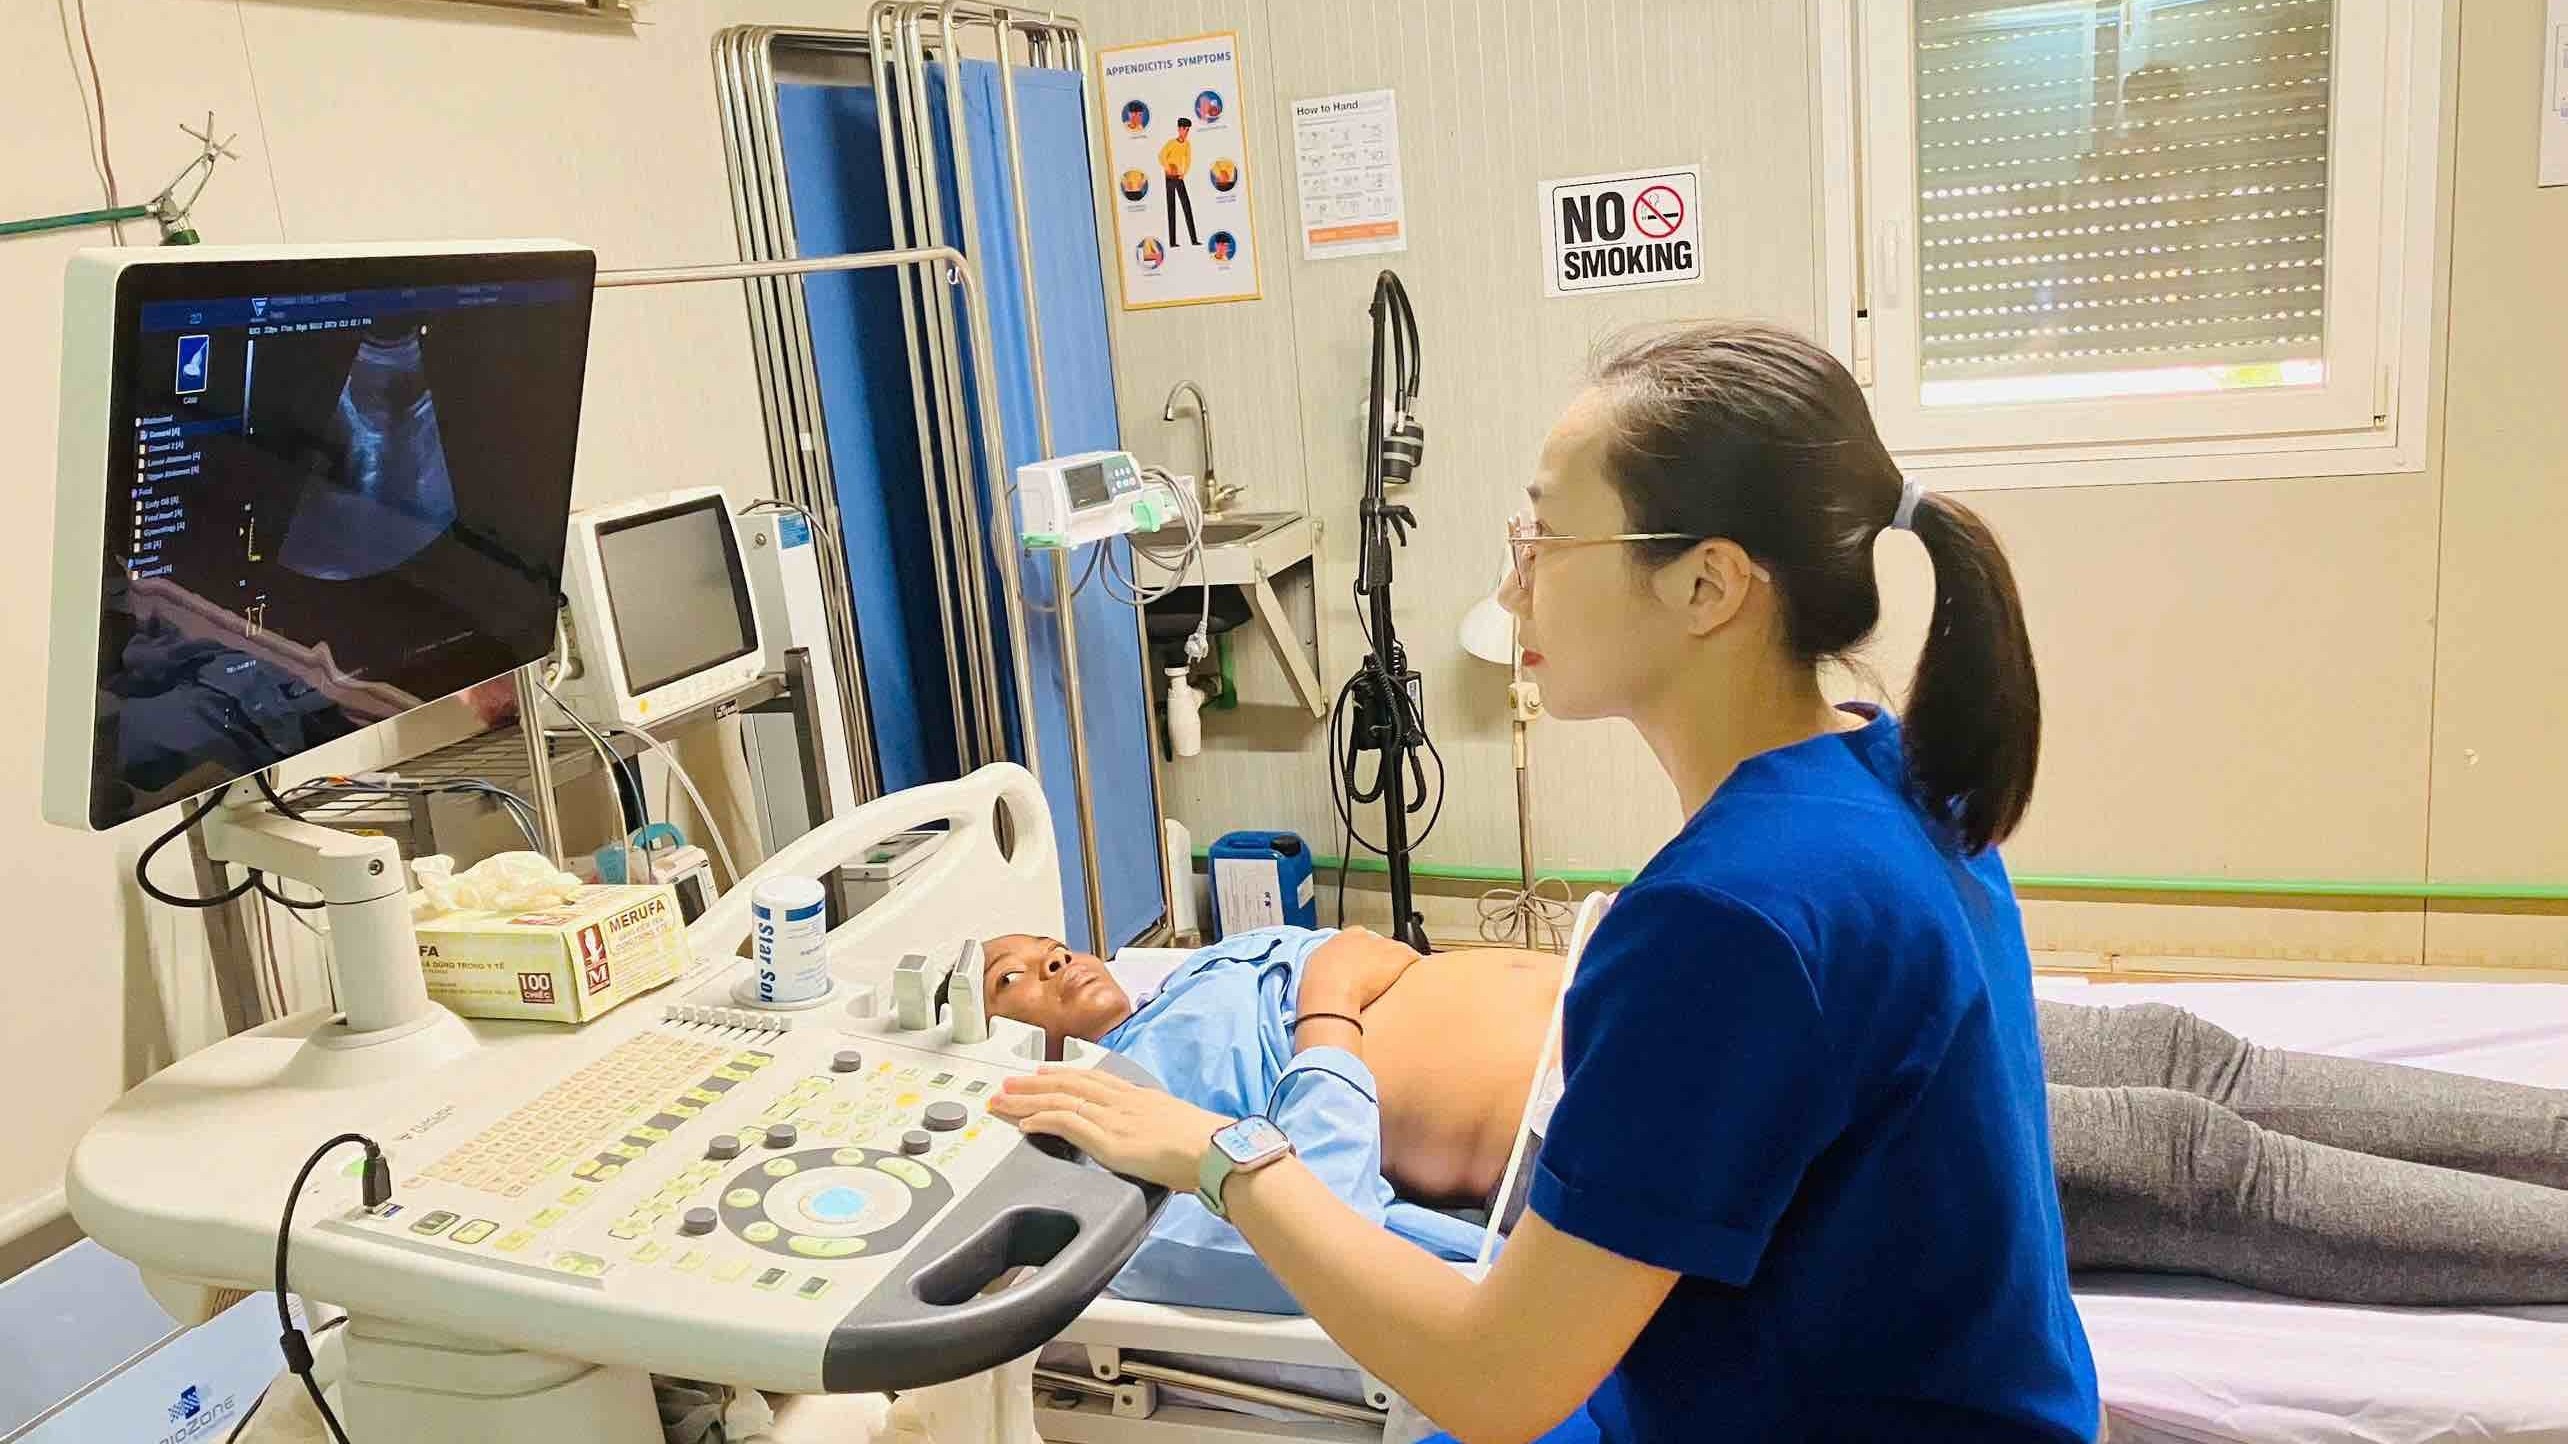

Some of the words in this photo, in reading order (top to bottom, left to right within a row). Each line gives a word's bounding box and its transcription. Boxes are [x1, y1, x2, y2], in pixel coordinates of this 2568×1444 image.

[1105, 59, 1173, 76] APPENDICITIS
[1177, 51, 1232, 68] SYMPTOMS
[1296, 106, 1318, 116] How
[1320, 104, 1331, 113] to
[1333, 100, 1359, 112] Hand
[1562, 191, 1626, 245] NO
[1564, 240, 1693, 281] SMOKING
[609, 899, 666, 933] MERUFA
[418, 945, 440, 957] FA
[758, 922, 774, 965] Star
[519, 974, 550, 991] 100
